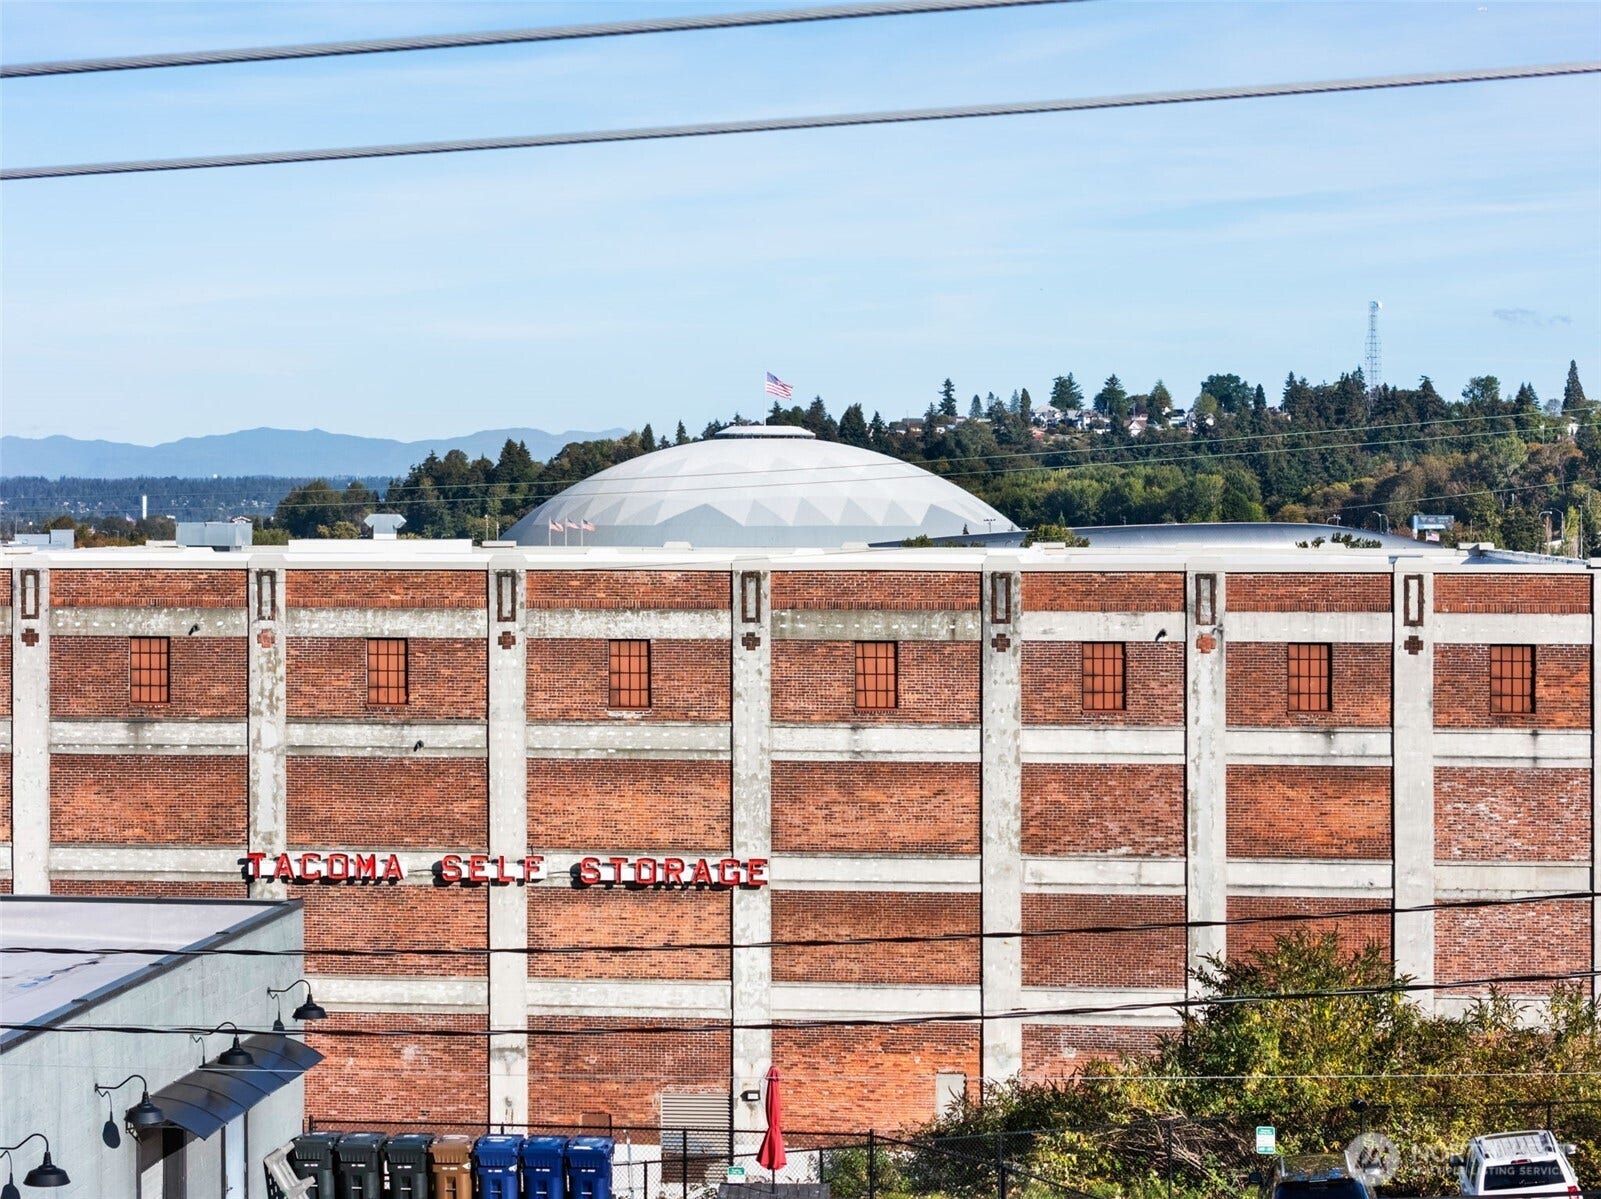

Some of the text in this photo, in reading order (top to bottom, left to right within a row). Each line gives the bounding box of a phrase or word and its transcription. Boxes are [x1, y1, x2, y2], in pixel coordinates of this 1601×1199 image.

[247, 852, 769, 886] TACOMA SELF STORAGE
